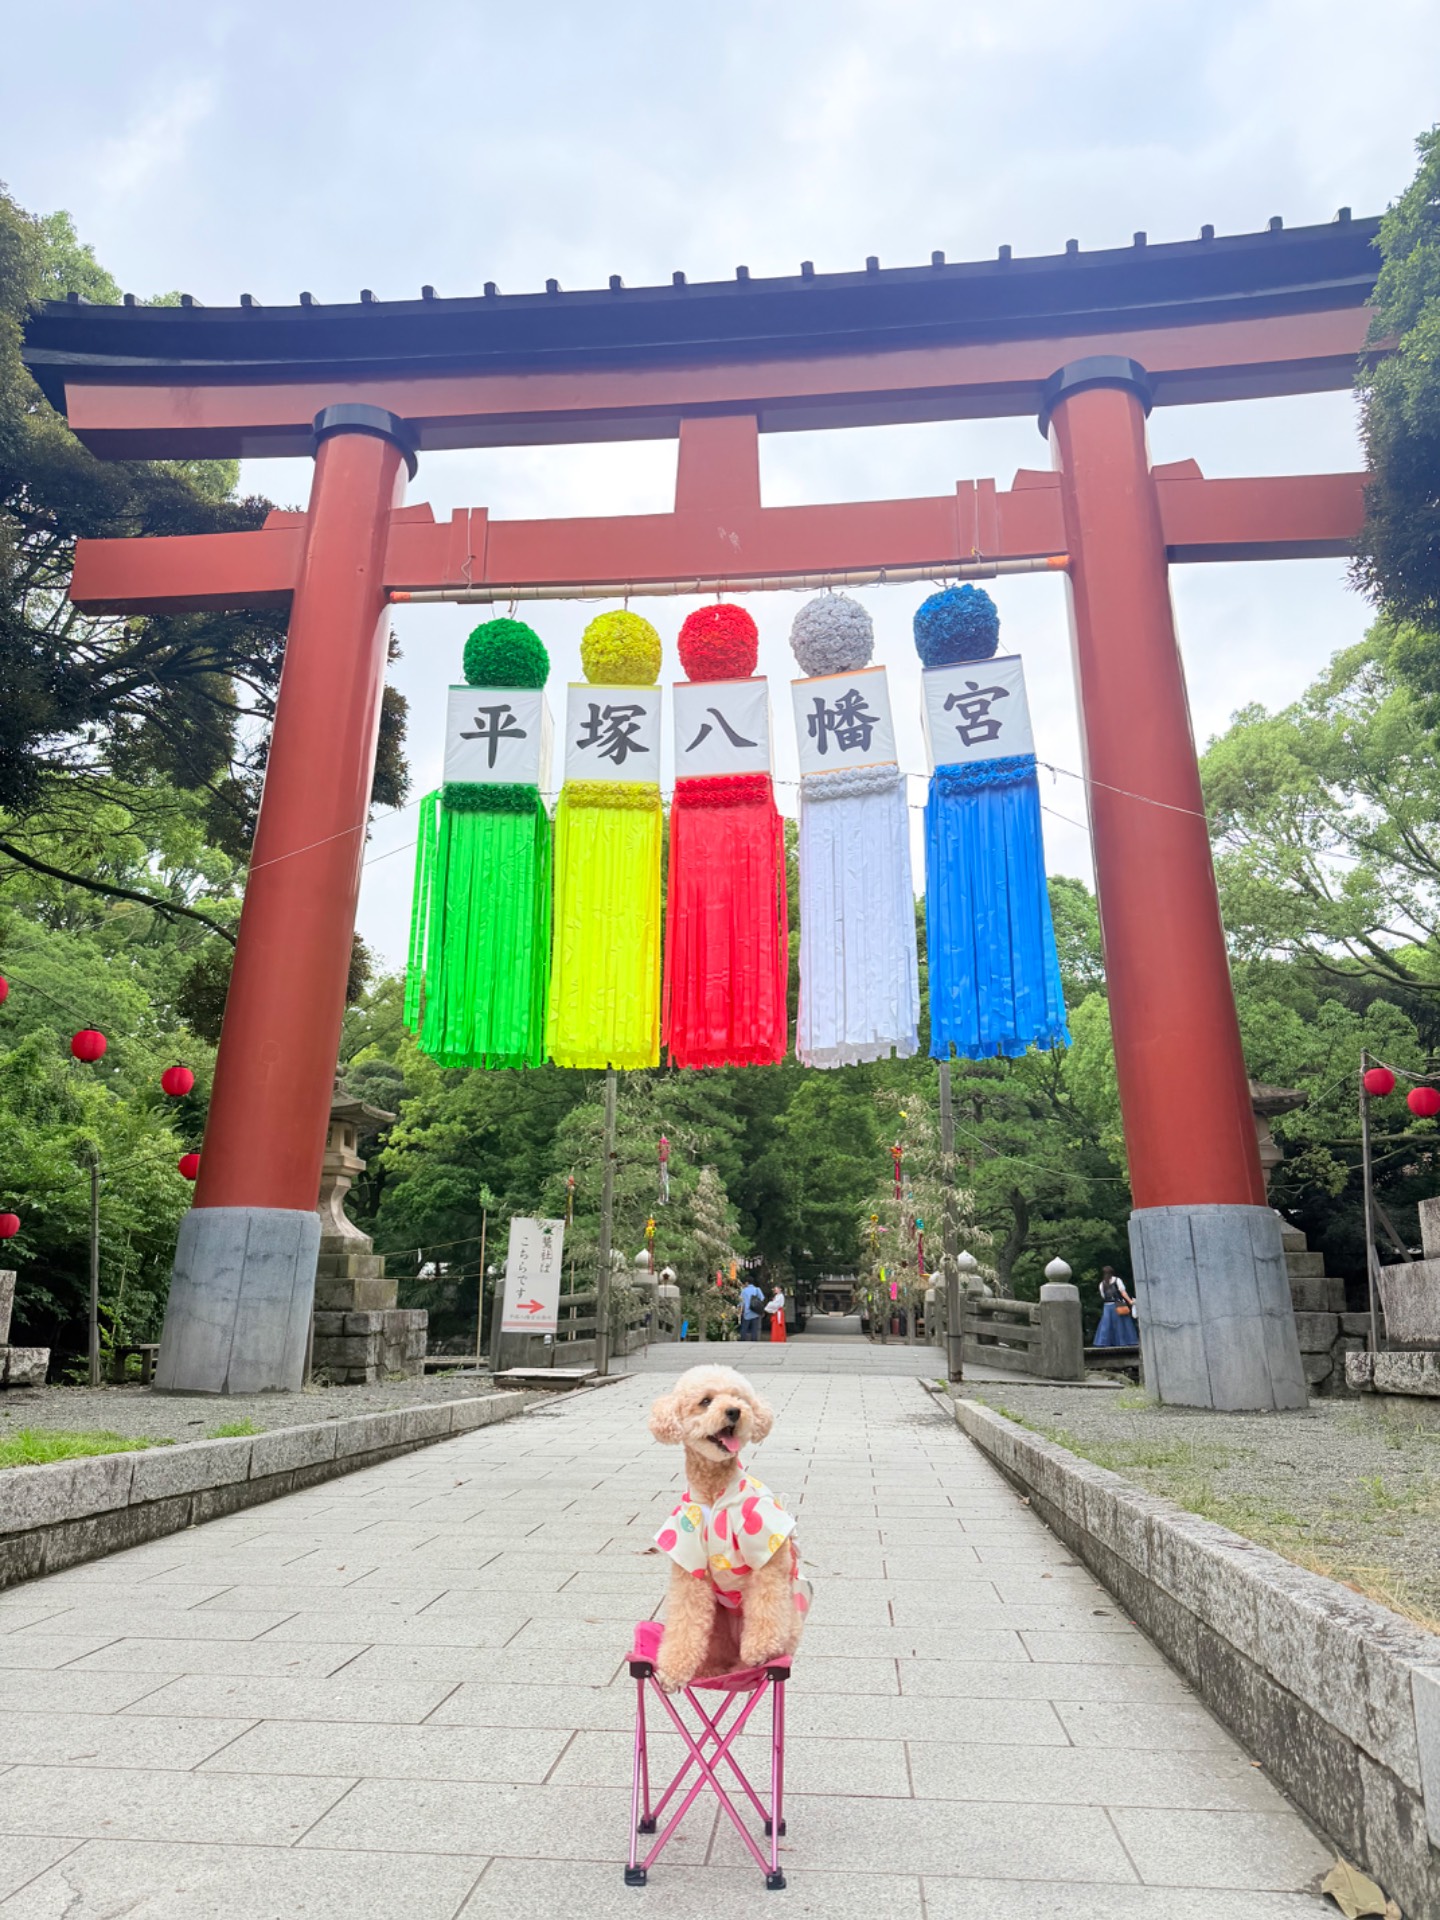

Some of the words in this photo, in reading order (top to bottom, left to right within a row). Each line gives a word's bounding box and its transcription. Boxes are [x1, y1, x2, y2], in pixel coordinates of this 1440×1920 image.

[516, 1236, 529, 1299] こちらです
